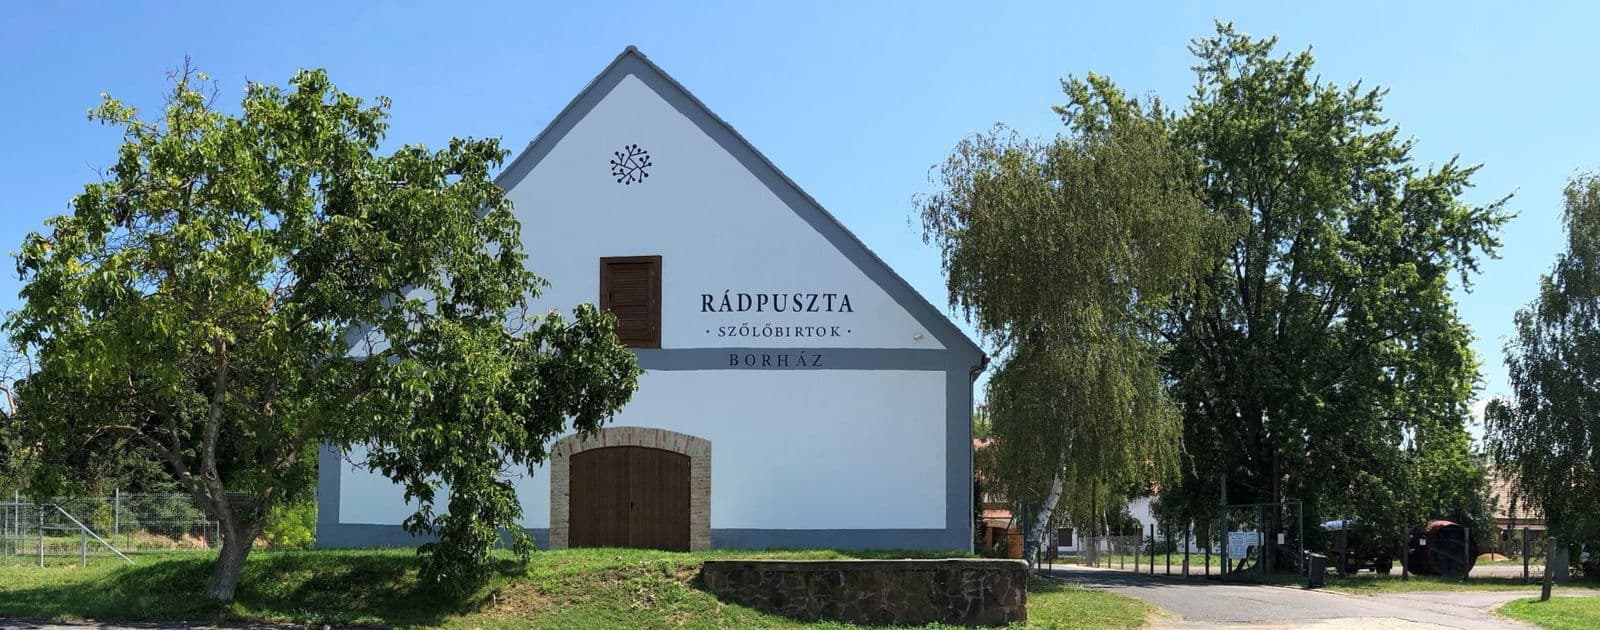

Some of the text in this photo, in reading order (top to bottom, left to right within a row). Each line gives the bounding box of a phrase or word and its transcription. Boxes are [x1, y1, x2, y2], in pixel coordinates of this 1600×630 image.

[700, 289, 854, 313] RÁDPUSZTA
[718, 322, 841, 338] SZŐLŐBIRTOK
[729, 350, 823, 367] BORHÁZ
